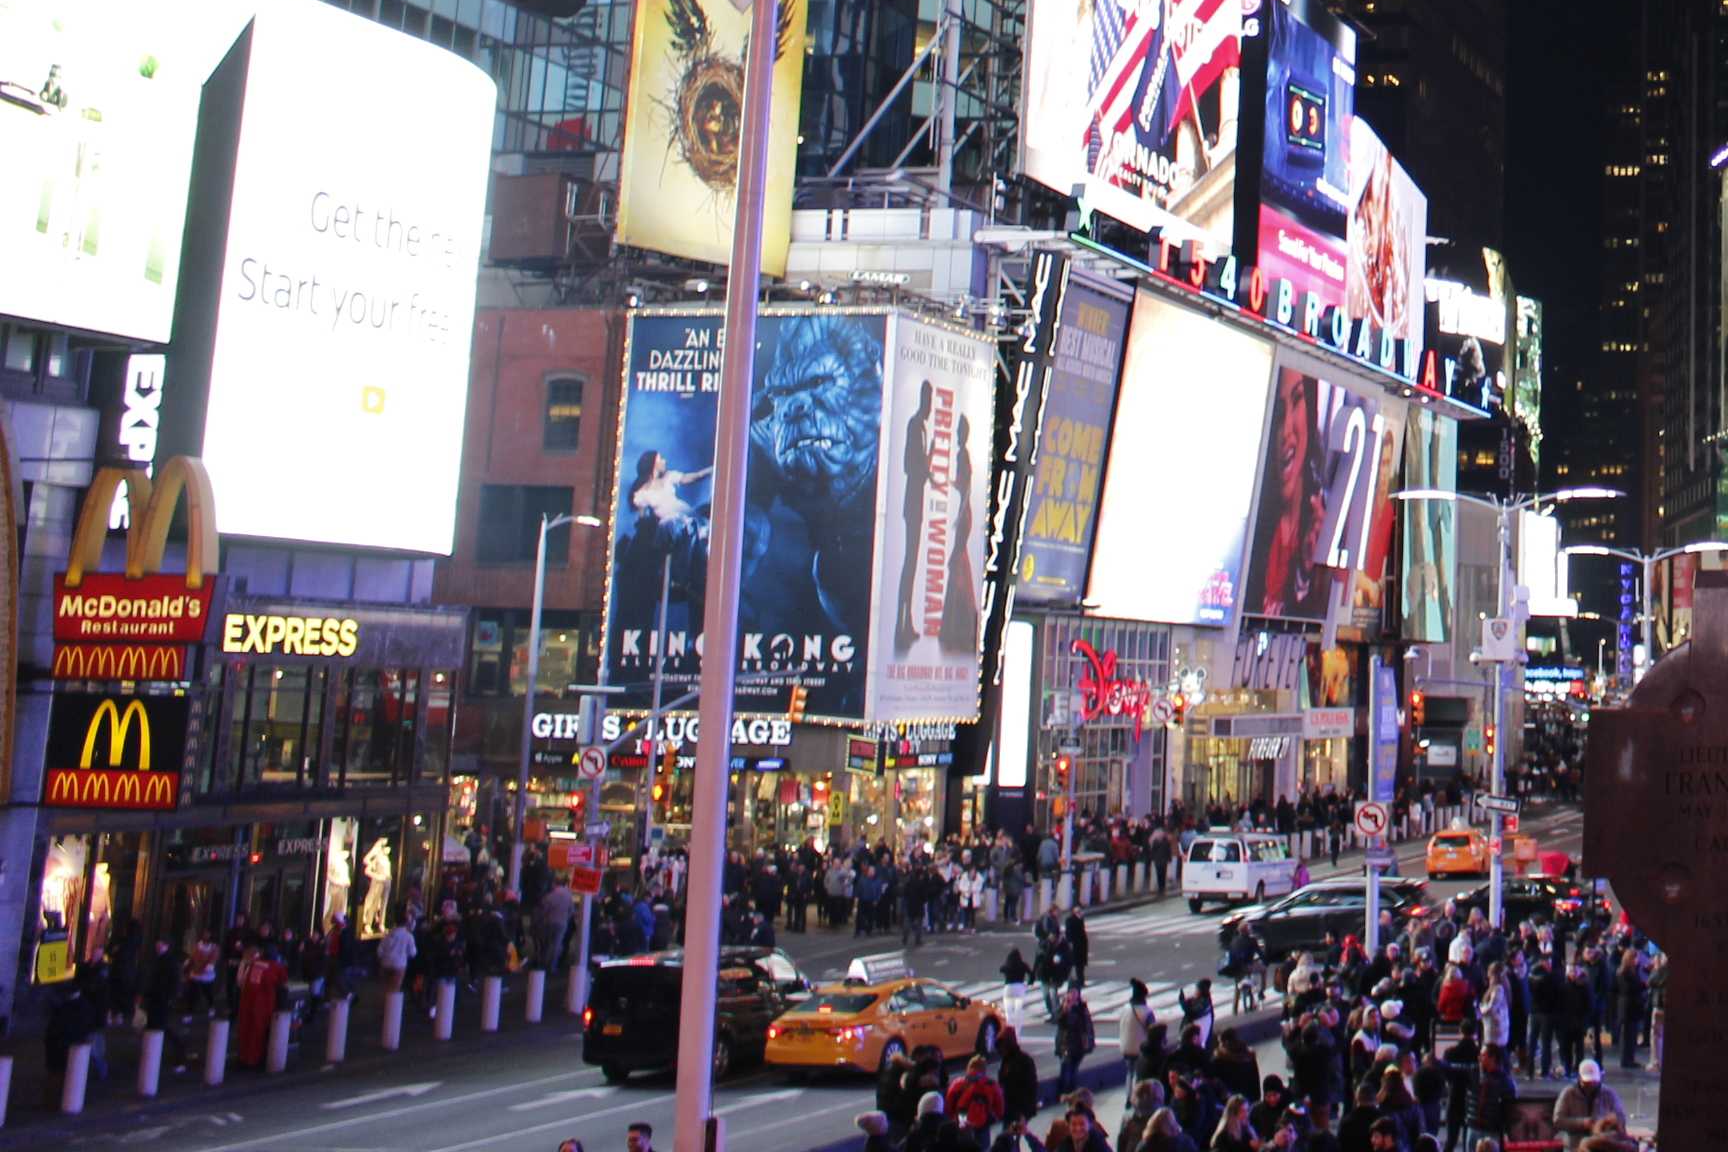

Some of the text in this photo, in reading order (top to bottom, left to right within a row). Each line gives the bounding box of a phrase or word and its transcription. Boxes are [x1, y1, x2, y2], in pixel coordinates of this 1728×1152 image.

[310, 190, 365, 245] Get
[374, 207, 421, 259] the
[237, 256, 322, 317] Start
[331, 286, 401, 334] your
[1158, 236, 1265, 312] 1540
[1276, 277, 1456, 396] BROADWAY
[636, 372, 721, 392] THRILL RI
[650, 350, 724, 370] DAZZLIN
[931, 387, 955, 504] PRETTY
[1045, 415, 1105, 466] COME
[1029, 500, 1092, 544] AWAY
[923, 512, 950, 638] WOMAN
[59, 594, 201, 619] McDonald's
[80, 619, 175, 636] Restaurant
[222, 613, 359, 657] EXPRESS
[741, 661, 855, 673] BROADWAY
[532, 713, 620, 740] GIFS
